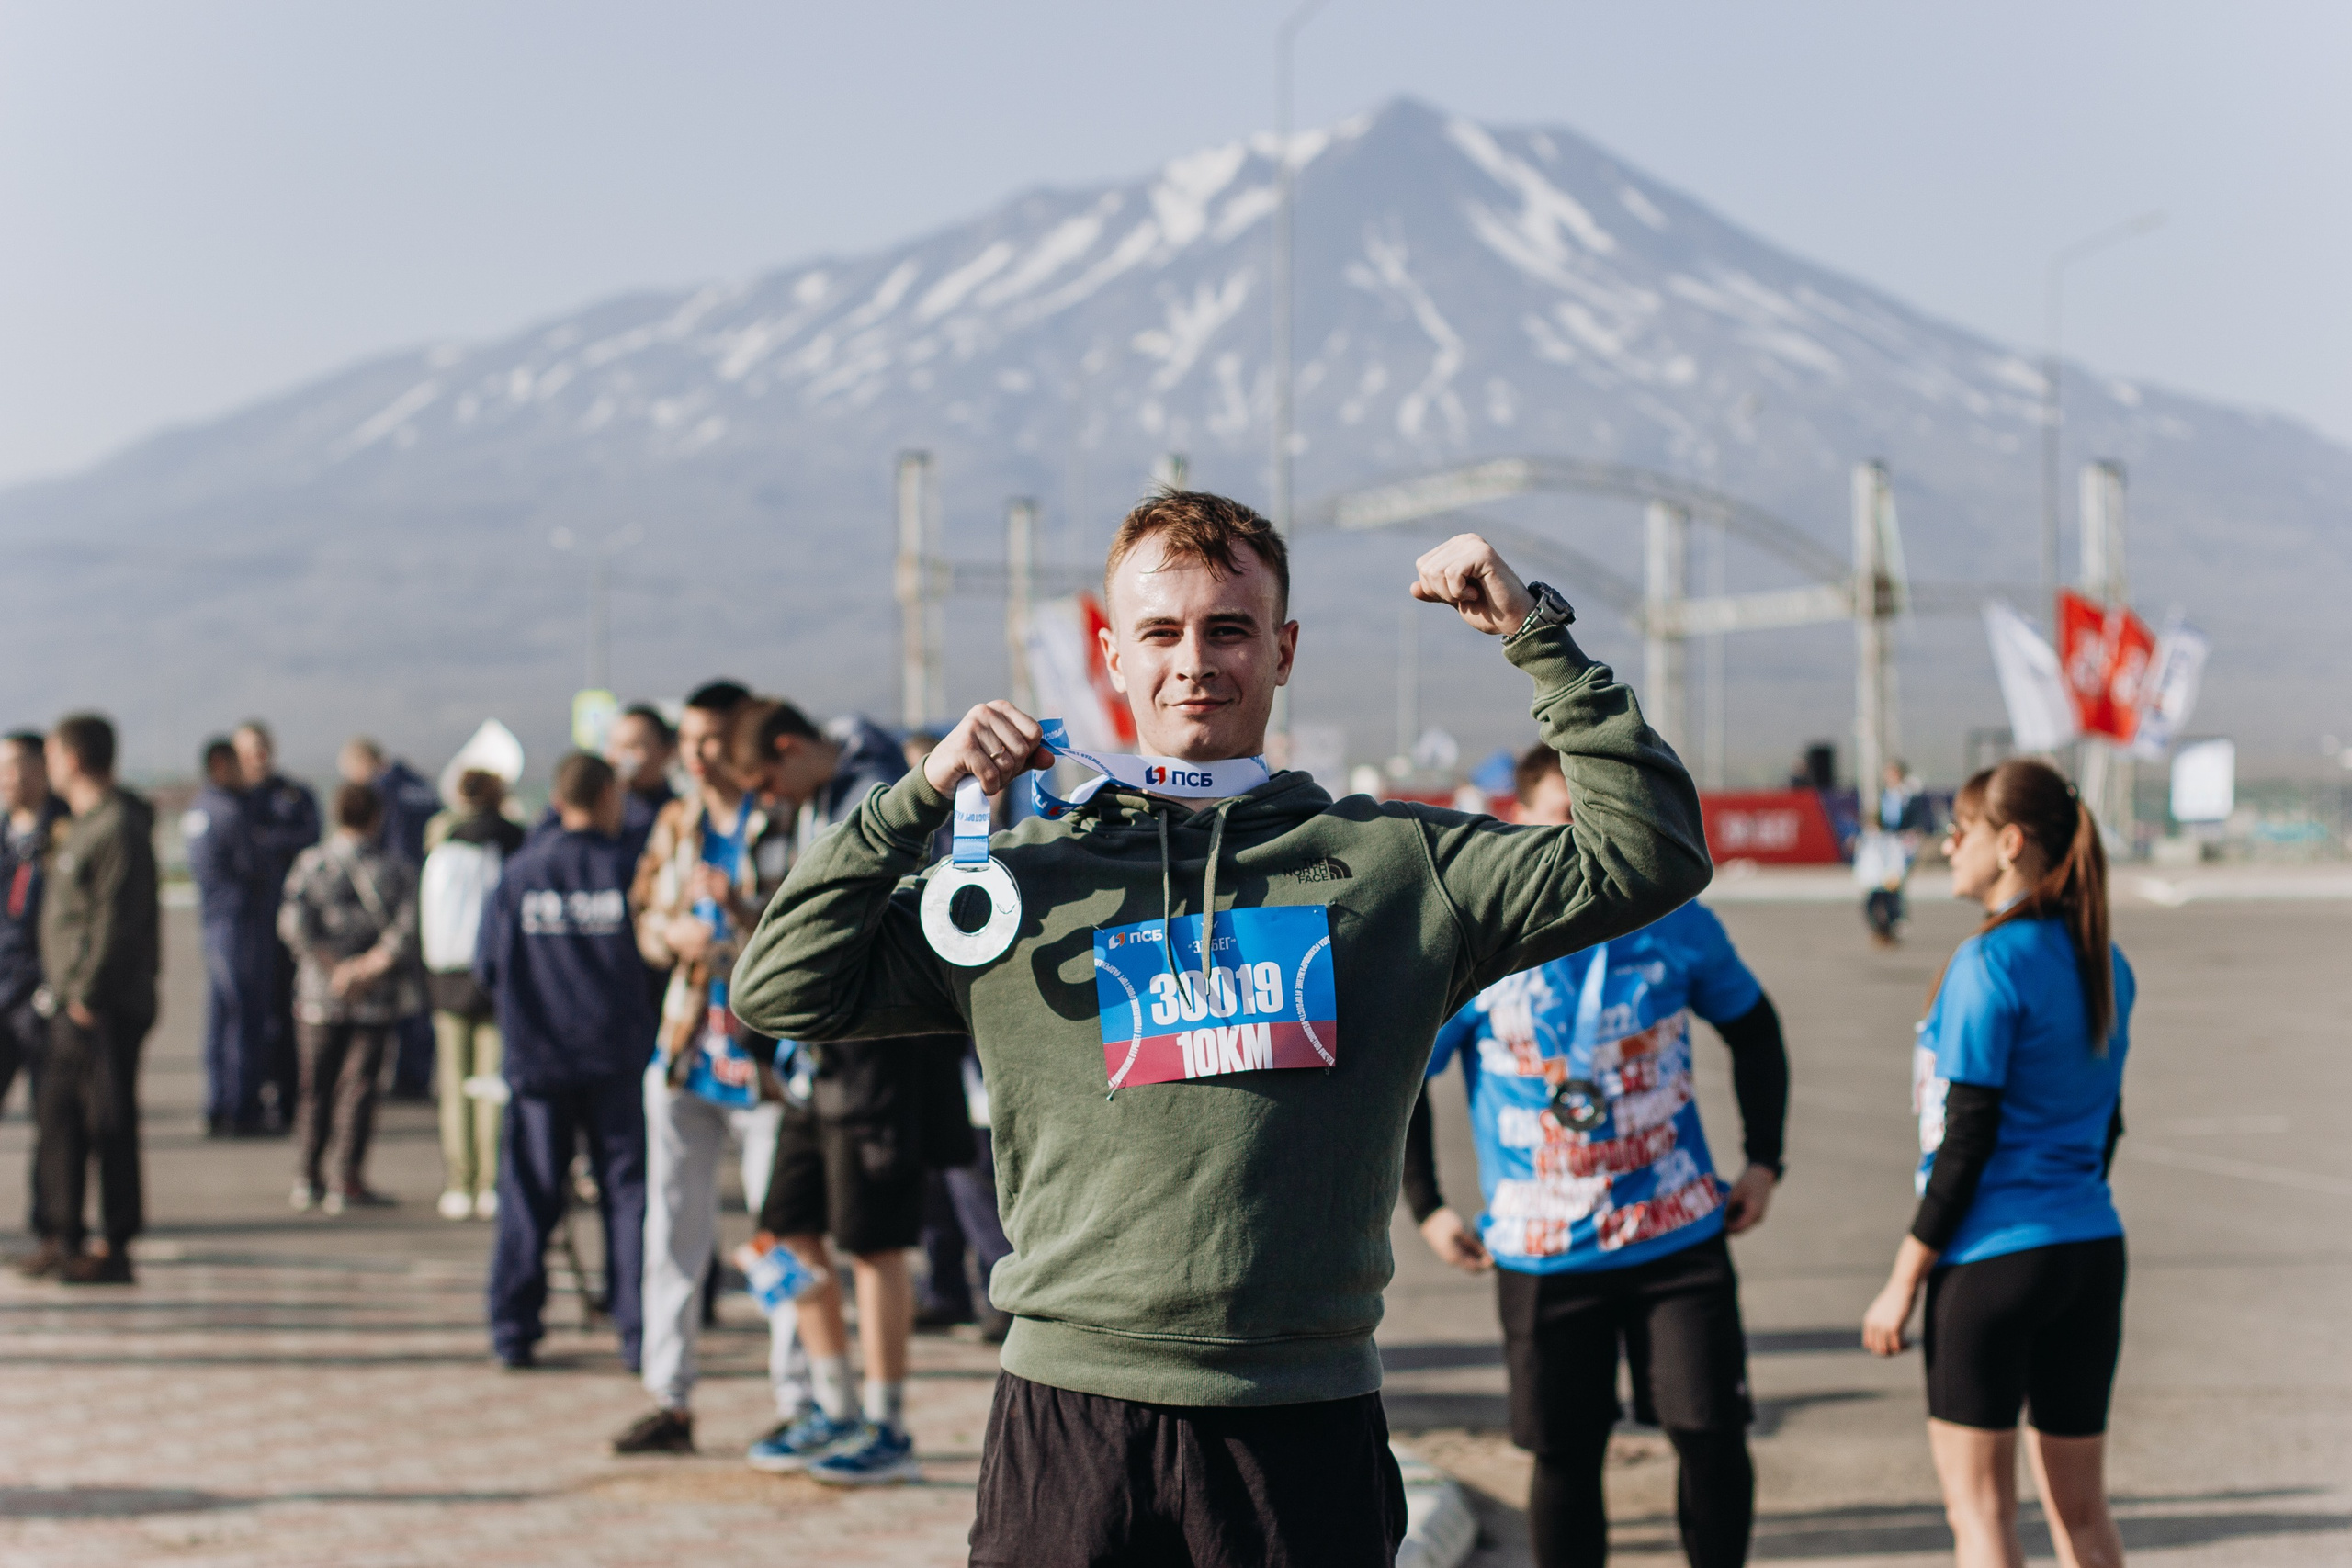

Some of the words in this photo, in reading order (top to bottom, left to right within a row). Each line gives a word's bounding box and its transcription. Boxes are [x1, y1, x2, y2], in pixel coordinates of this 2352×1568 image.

[1171, 770, 1213, 787] ПСБ
[1302, 858, 1326, 867] THE
[1283, 865, 1328, 876] NORTH
[1297, 874, 1329, 884] FACE
[1129, 928, 1163, 944] ПСБ
[1149, 961, 1284, 1025] 30019
